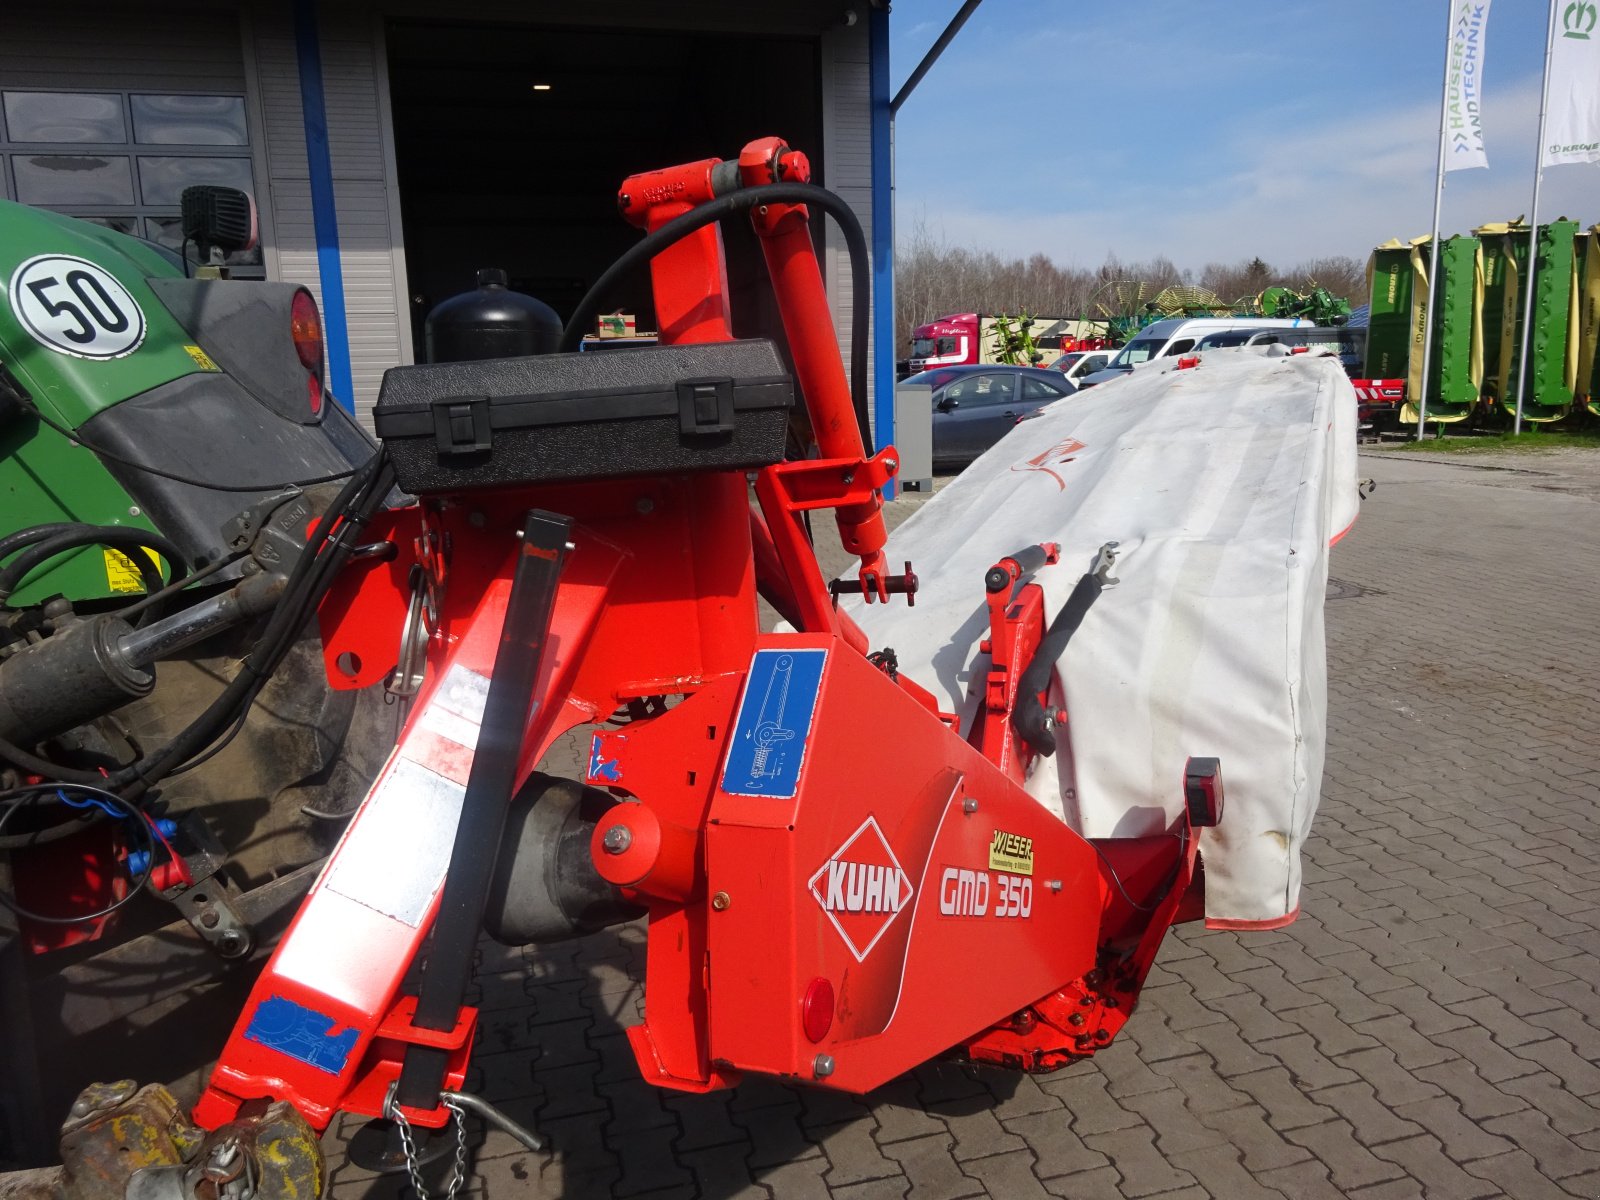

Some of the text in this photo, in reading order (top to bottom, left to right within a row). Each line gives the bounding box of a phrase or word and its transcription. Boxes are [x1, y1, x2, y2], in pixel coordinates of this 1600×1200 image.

[1450, 42, 1464, 129] HAUSER
[1562, 143, 1599, 152] KRONE
[26, 270, 129, 344] 50
[1388, 273, 1397, 304] KRONE
[993, 829, 1032, 860] WIESER
[826, 860, 901, 913] KUHN
[940, 868, 1033, 918] GMD 350
